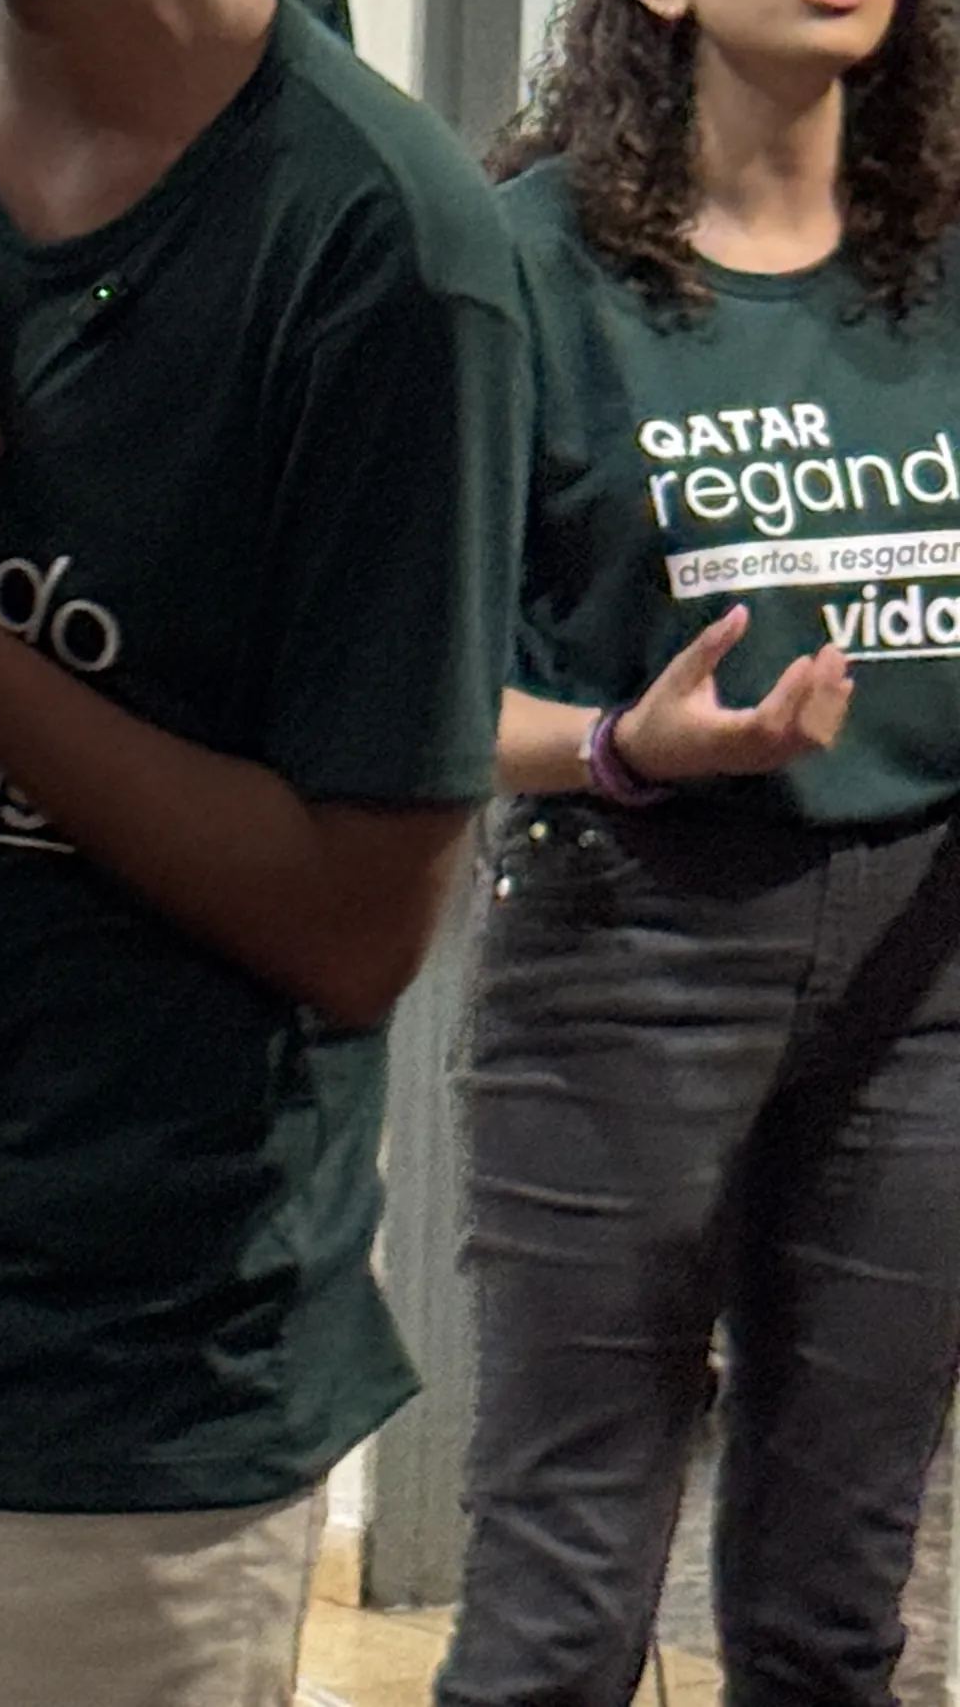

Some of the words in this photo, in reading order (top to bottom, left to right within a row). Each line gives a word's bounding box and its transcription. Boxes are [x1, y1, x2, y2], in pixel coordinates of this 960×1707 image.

[640, 403, 831, 459] QATAR
[648, 432, 960, 537] regand
[677, 548, 820, 588] desertos,
[822, 583, 960, 649] vida
